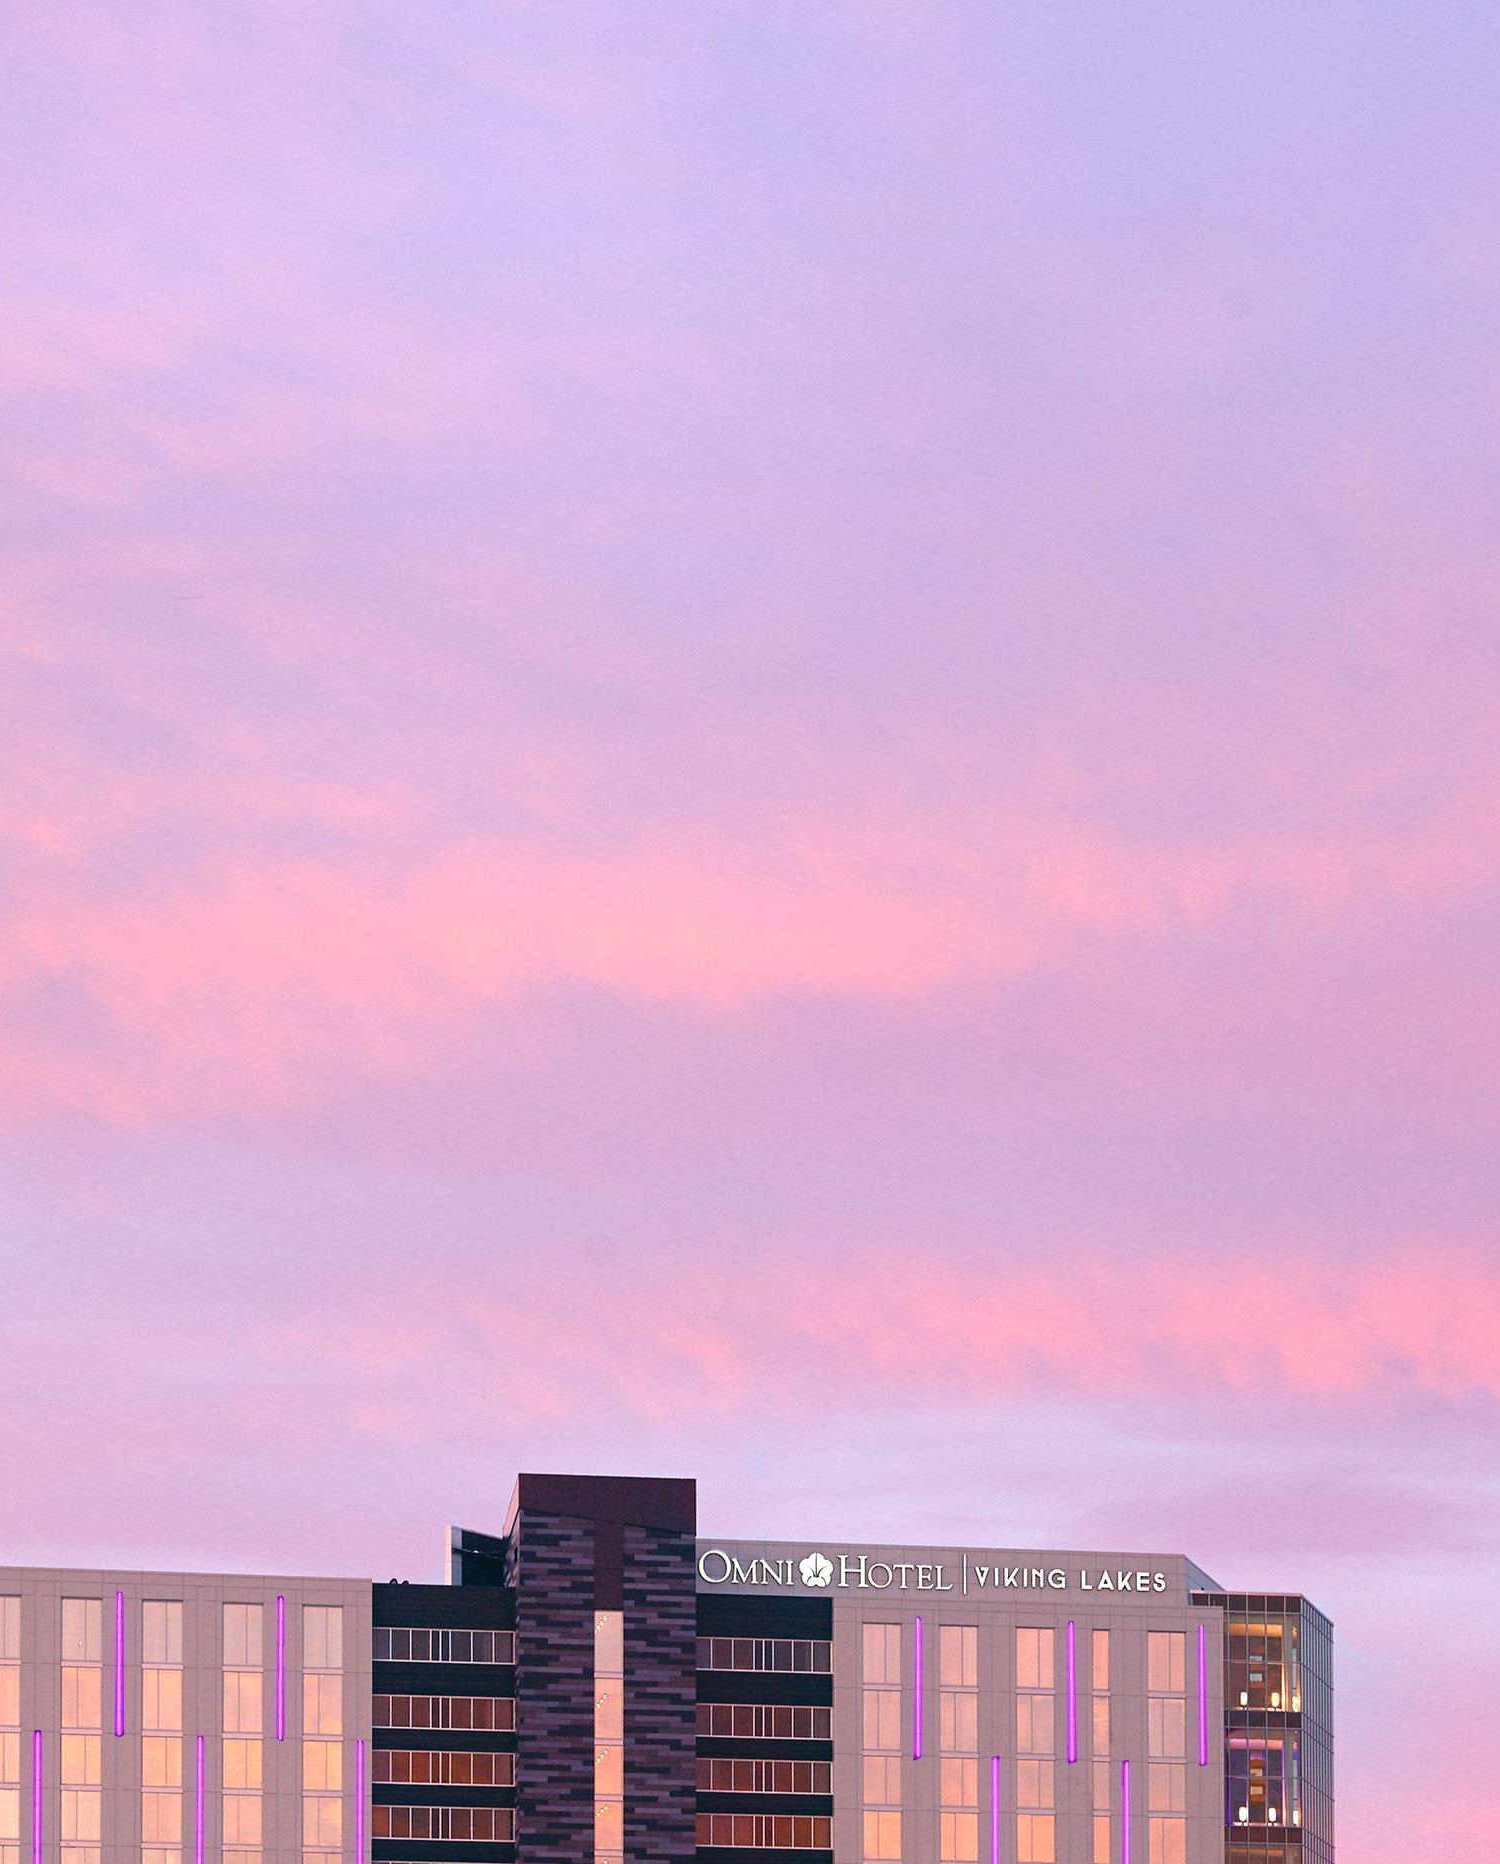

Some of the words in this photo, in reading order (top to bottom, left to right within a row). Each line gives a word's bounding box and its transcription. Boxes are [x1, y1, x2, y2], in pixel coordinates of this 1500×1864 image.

[698, 1549, 794, 1585] OMNI
[837, 1554, 953, 1590] HOTEL
[974, 1566, 1066, 1589] VIKING
[1080, 1569, 1167, 1592] LAKES
